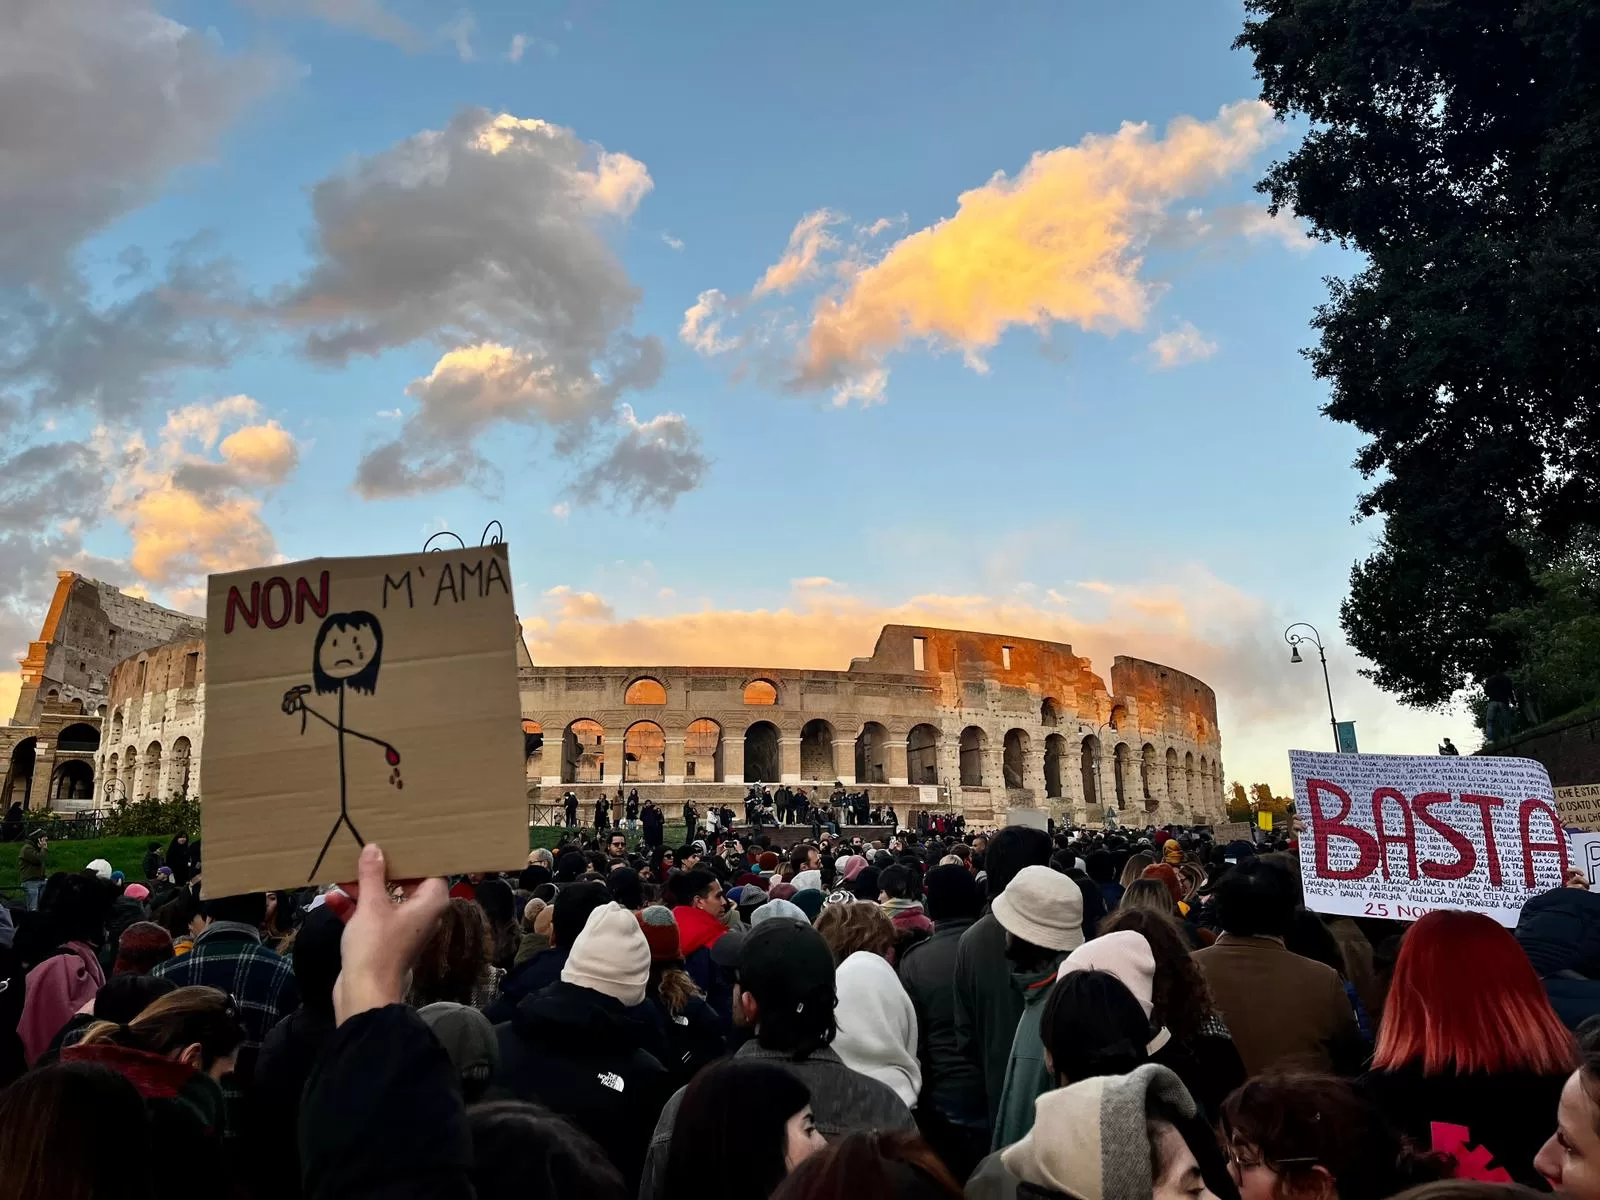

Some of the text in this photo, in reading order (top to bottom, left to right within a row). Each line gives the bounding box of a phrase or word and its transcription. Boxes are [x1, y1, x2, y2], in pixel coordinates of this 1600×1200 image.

[223, 557, 509, 634] NON M'AMA
[1558, 789, 1573, 798] CHE
[1581, 786, 1599, 796] STAT
[1566, 800, 1591, 811] OSATO
[1576, 815, 1586, 823] ALI
[1306, 778, 1568, 889] BASTA
[1364, 902, 1389, 917] 25
